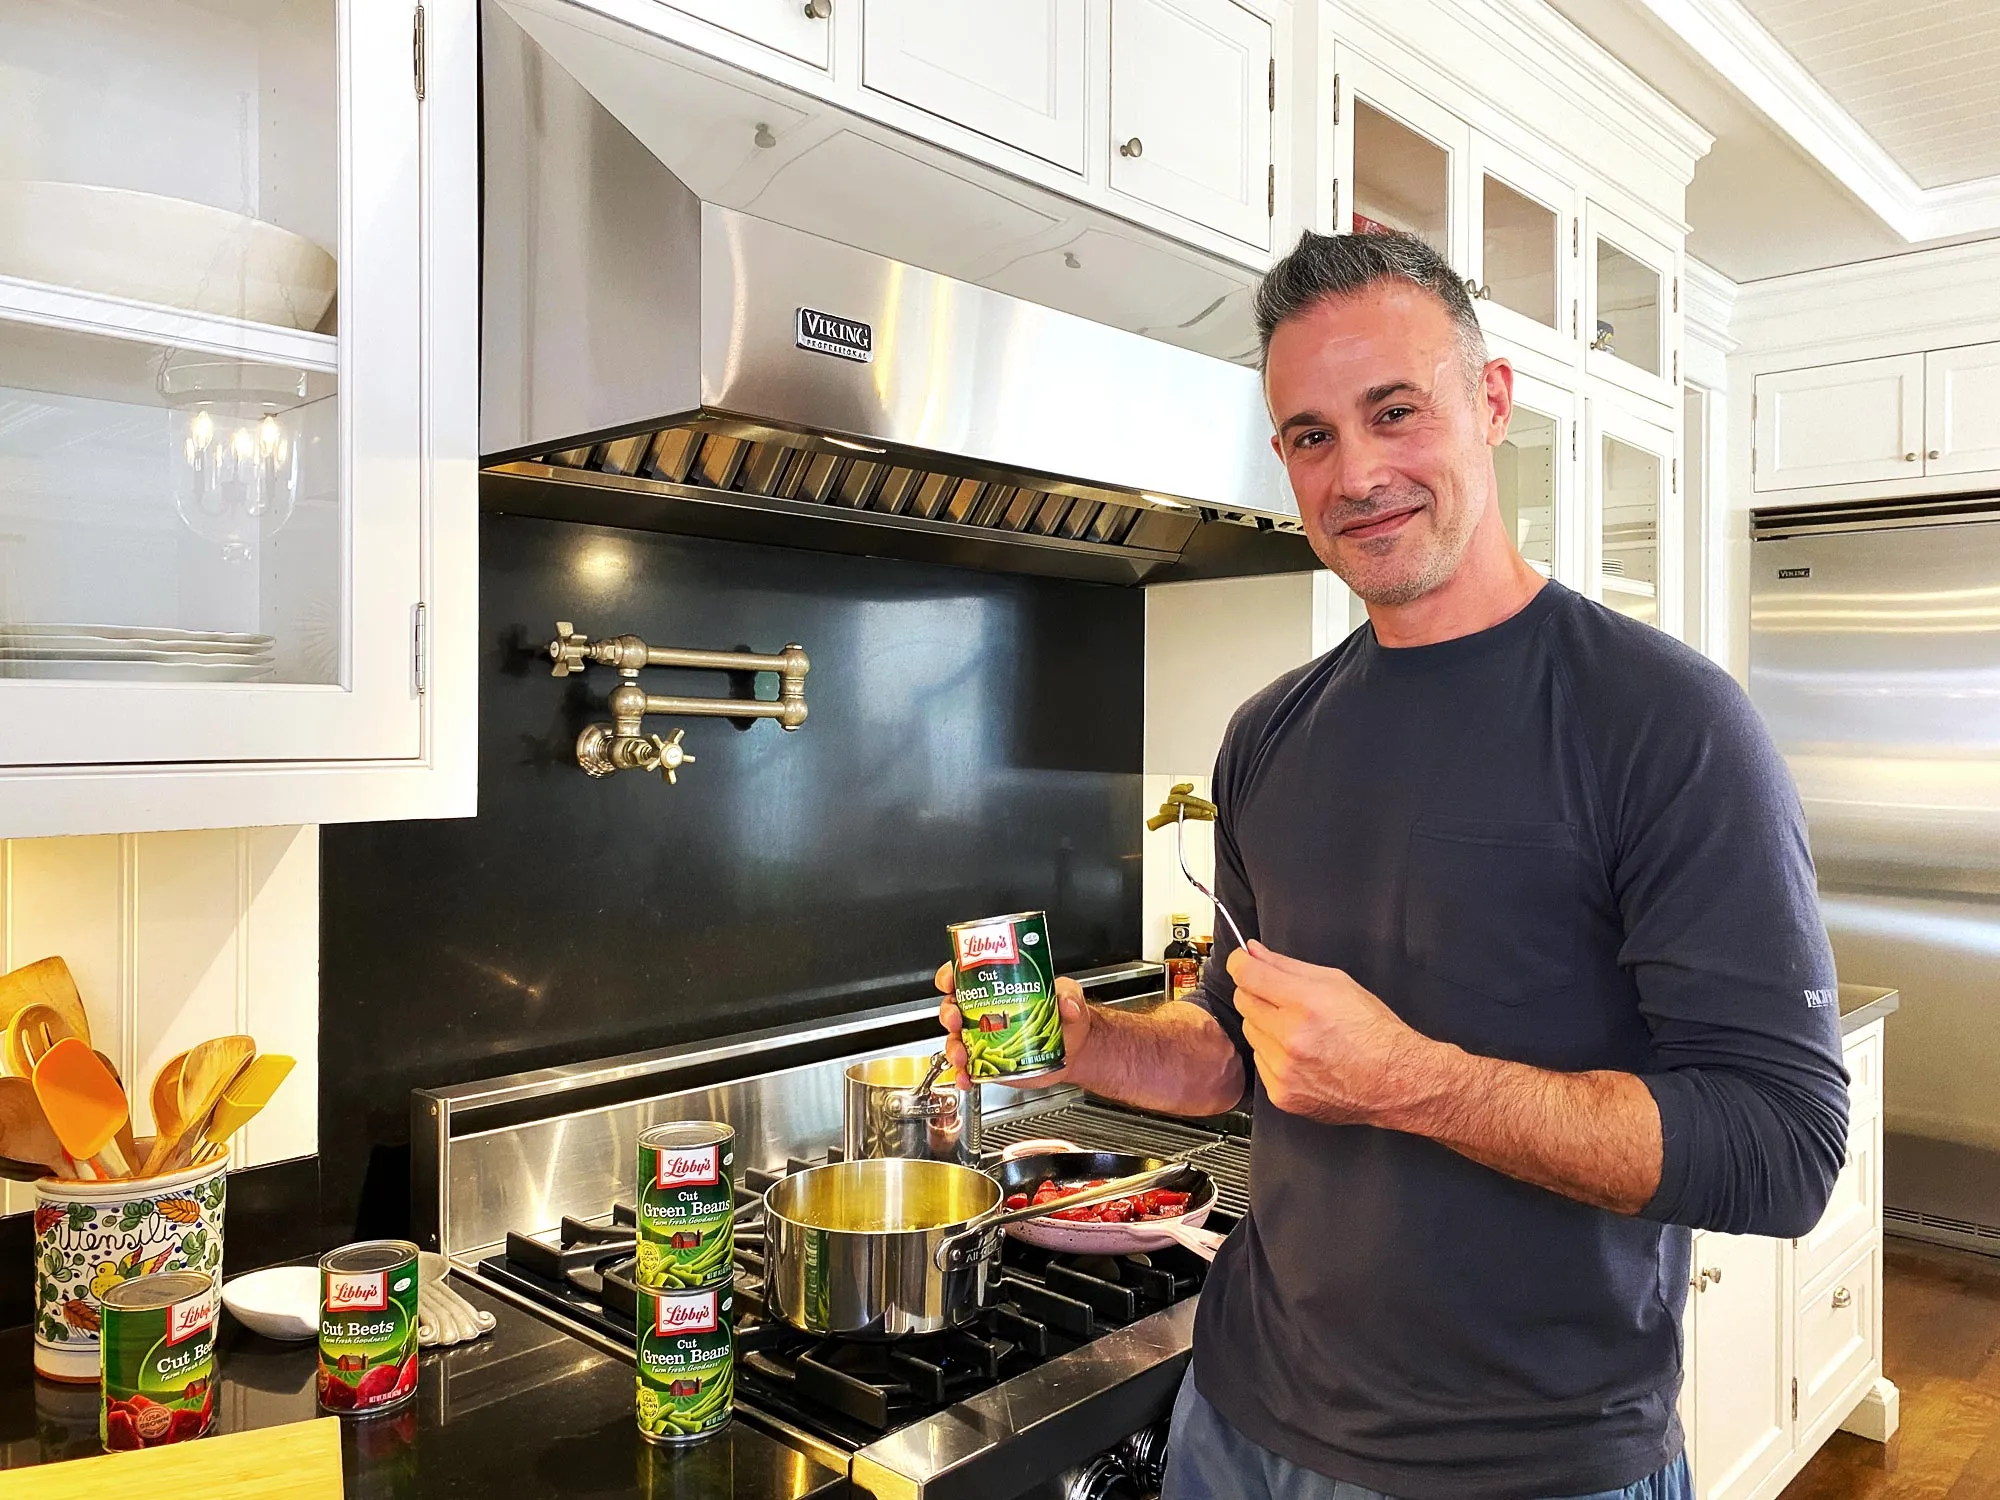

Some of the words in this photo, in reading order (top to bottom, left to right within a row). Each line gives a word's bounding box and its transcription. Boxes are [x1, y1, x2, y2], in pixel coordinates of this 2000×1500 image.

[805, 311, 869, 348] VIKING
[806, 339, 868, 360] PROFESSIONAL
[963, 935, 1009, 957] Libby's
[978, 969, 999, 983] Cut
[955, 987, 989, 1004] Green
[993, 980, 1041, 997] Beans
[664, 1157, 711, 1178] Libby's
[677, 1191, 699, 1202] Cut
[643, 1203, 686, 1218] Green
[691, 1200, 731, 1216] Beans
[652, 1218, 668, 1227] Farm
[668, 1217, 687, 1226] Fresh
[333, 1282, 378, 1303] Libby's
[663, 1305, 710, 1326] Libby's
[322, 1320, 344, 1337] Cut
[347, 1320, 395, 1336] Beets
[643, 1350, 685, 1366] Green
[690, 1344, 730, 1364] Beans
[676, 1339, 698, 1350] Cut
[156, 1351, 191, 1374] Cut
[194, 1341, 213, 1361] Bee
[161, 1371, 181, 1382] Farm
[181, 1361, 198, 1376] Fresh
[651, 1366, 667, 1374] Farm
[667, 1364, 686, 1374] Fresh
[145, 1413, 161, 1422] USA
